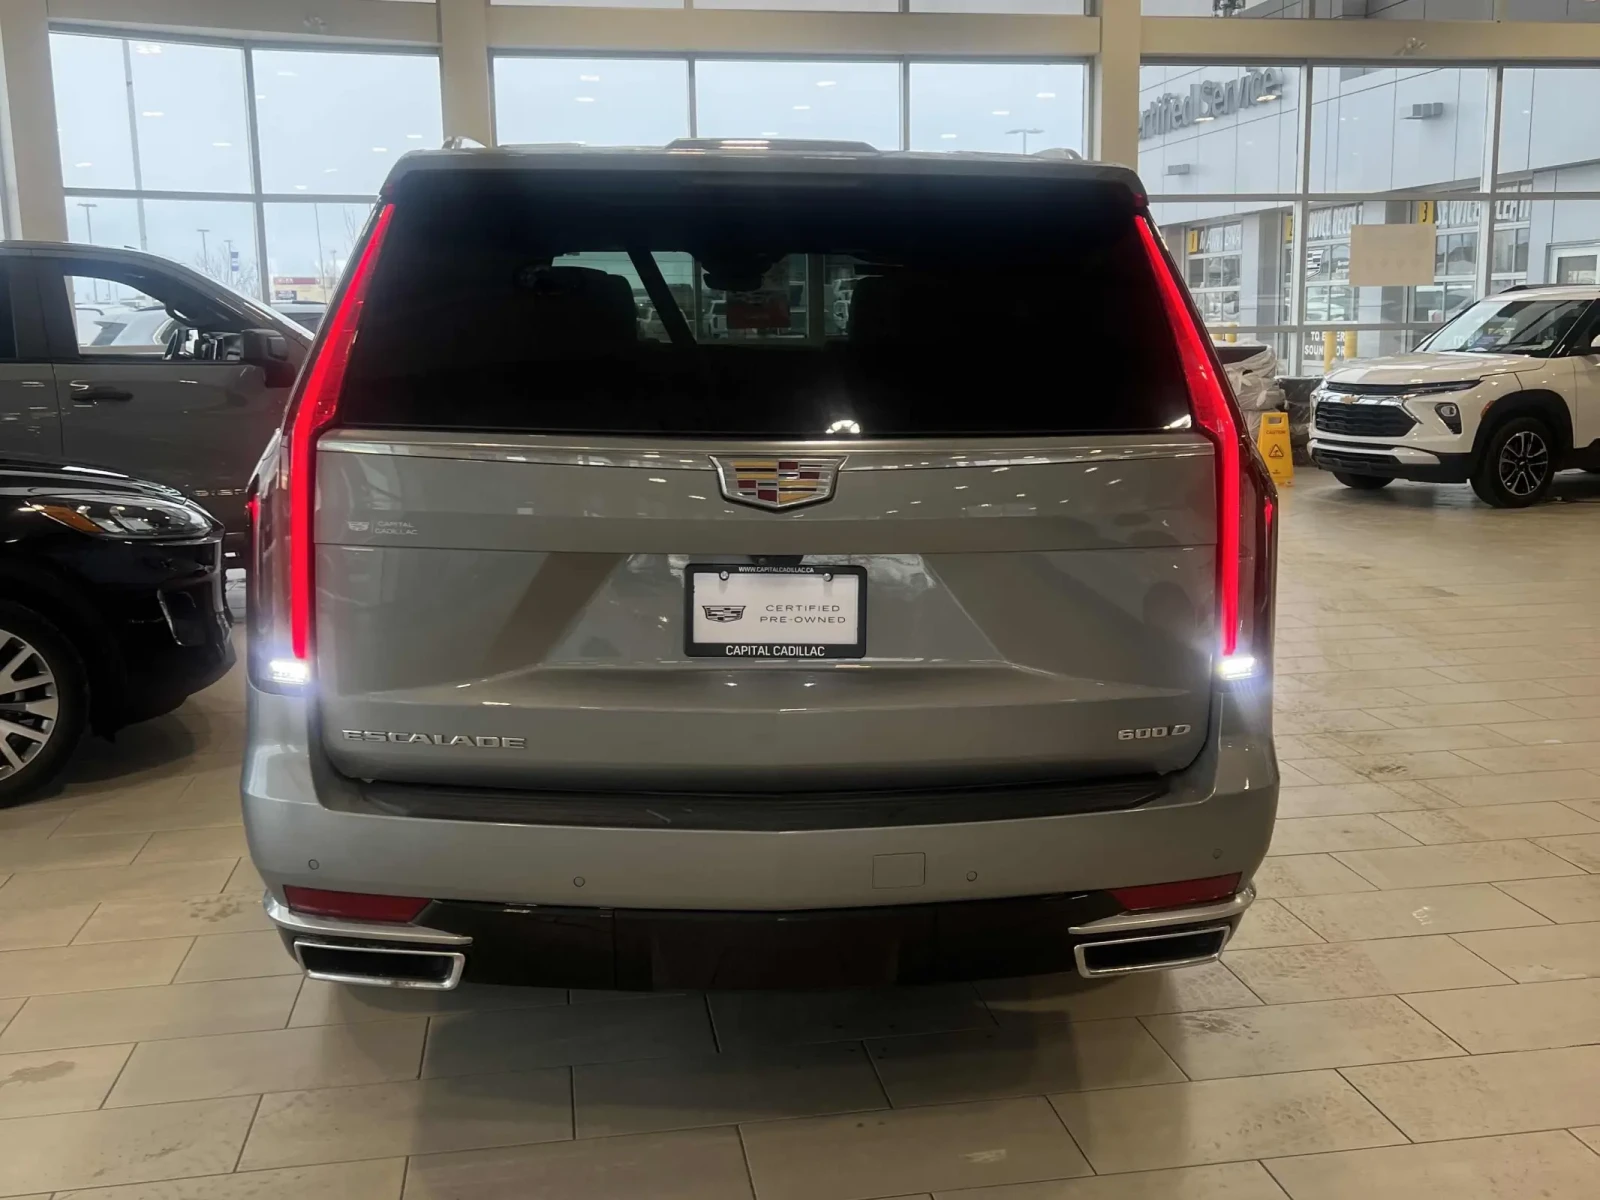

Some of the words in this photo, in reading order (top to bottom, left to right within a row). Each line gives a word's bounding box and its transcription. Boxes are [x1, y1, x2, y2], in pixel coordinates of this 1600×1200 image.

[1140, 84, 1199, 139] rtified
[1201, 67, 1280, 117] Service
[1311, 331, 1320, 341] TO
[1322, 331, 1345, 342] EER
[1304, 345, 1324, 355] SOUN
[374, 527, 418, 535] CADILLAC
[765, 604, 841, 612] CERTIFIED
[759, 616, 846, 624] PRE-OWNED
[725, 645, 771, 656] CAPITAL
[773, 645, 825, 657] CADILLAC
[342, 729, 527, 749] ESCALADE
